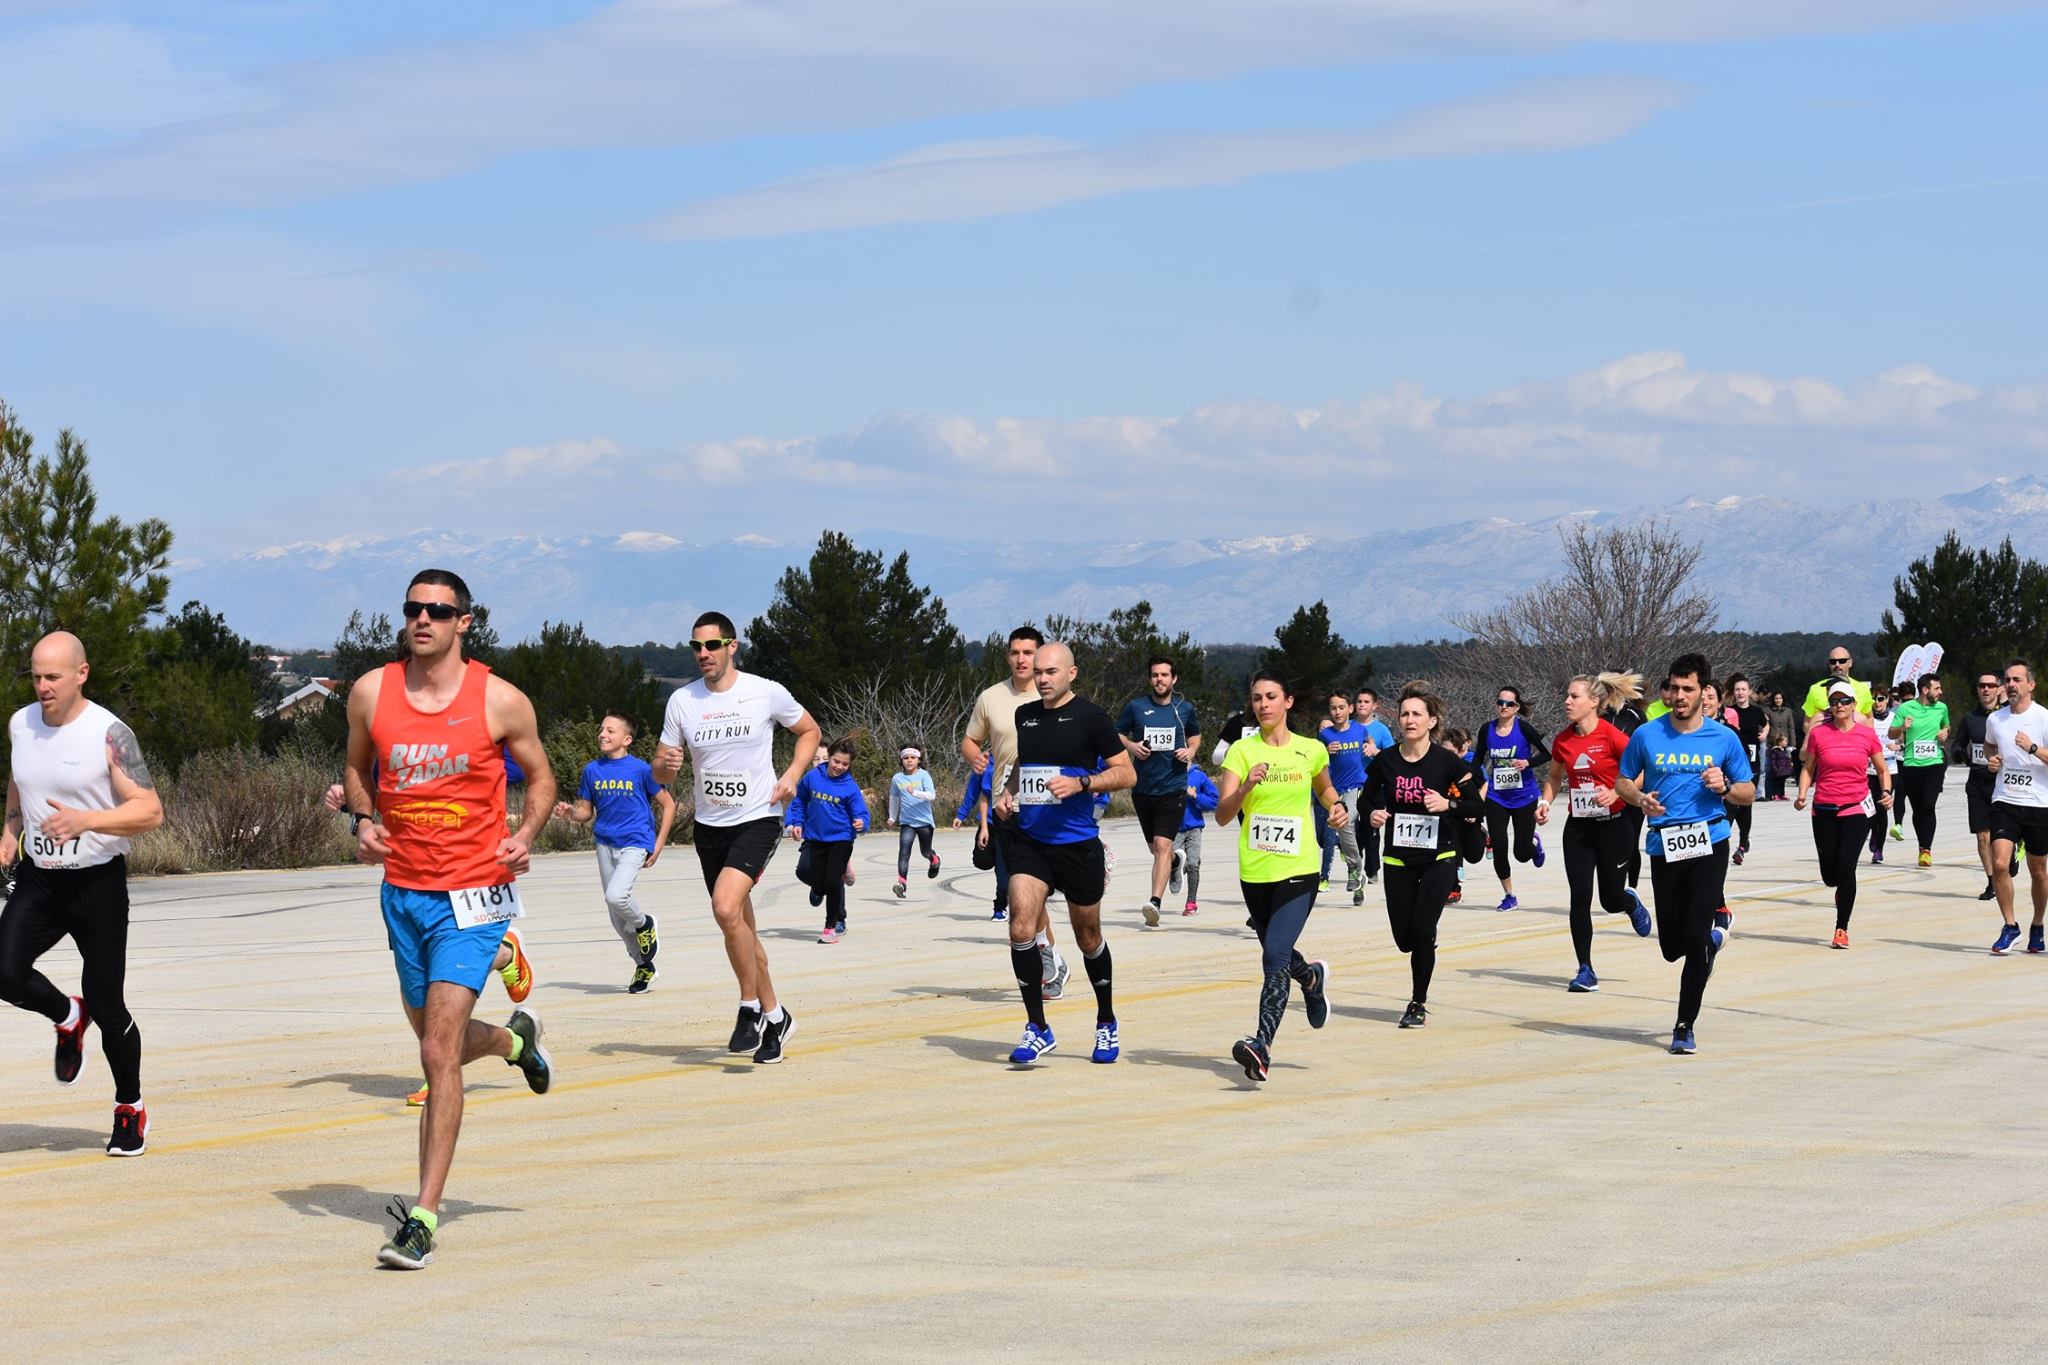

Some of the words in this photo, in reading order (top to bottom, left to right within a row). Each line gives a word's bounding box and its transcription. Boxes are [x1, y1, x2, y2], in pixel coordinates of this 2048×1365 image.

[694, 728, 722, 742] CITY
[725, 724, 751, 738] RUN
[1146, 734, 1172, 744] 1139
[1915, 745, 1936, 753] 2544
[388, 743, 449, 772] RUN
[395, 753, 471, 792] ZADAR
[1263, 773, 1289, 783] WORLD
[1288, 772, 1303, 781] RUN
[1496, 773, 1520, 784] 5089
[2003, 773, 2033, 787] 2562
[594, 779, 633, 790] ZADAR
[704, 780, 747, 797] 2559
[1021, 778, 1046, 794] 116
[1396, 775, 1424, 790] RUN
[1252, 824, 1296, 844] 1174
[1397, 823, 1433, 839] 1171
[1667, 831, 1708, 852] 5094
[459, 882, 514, 911] 1181
